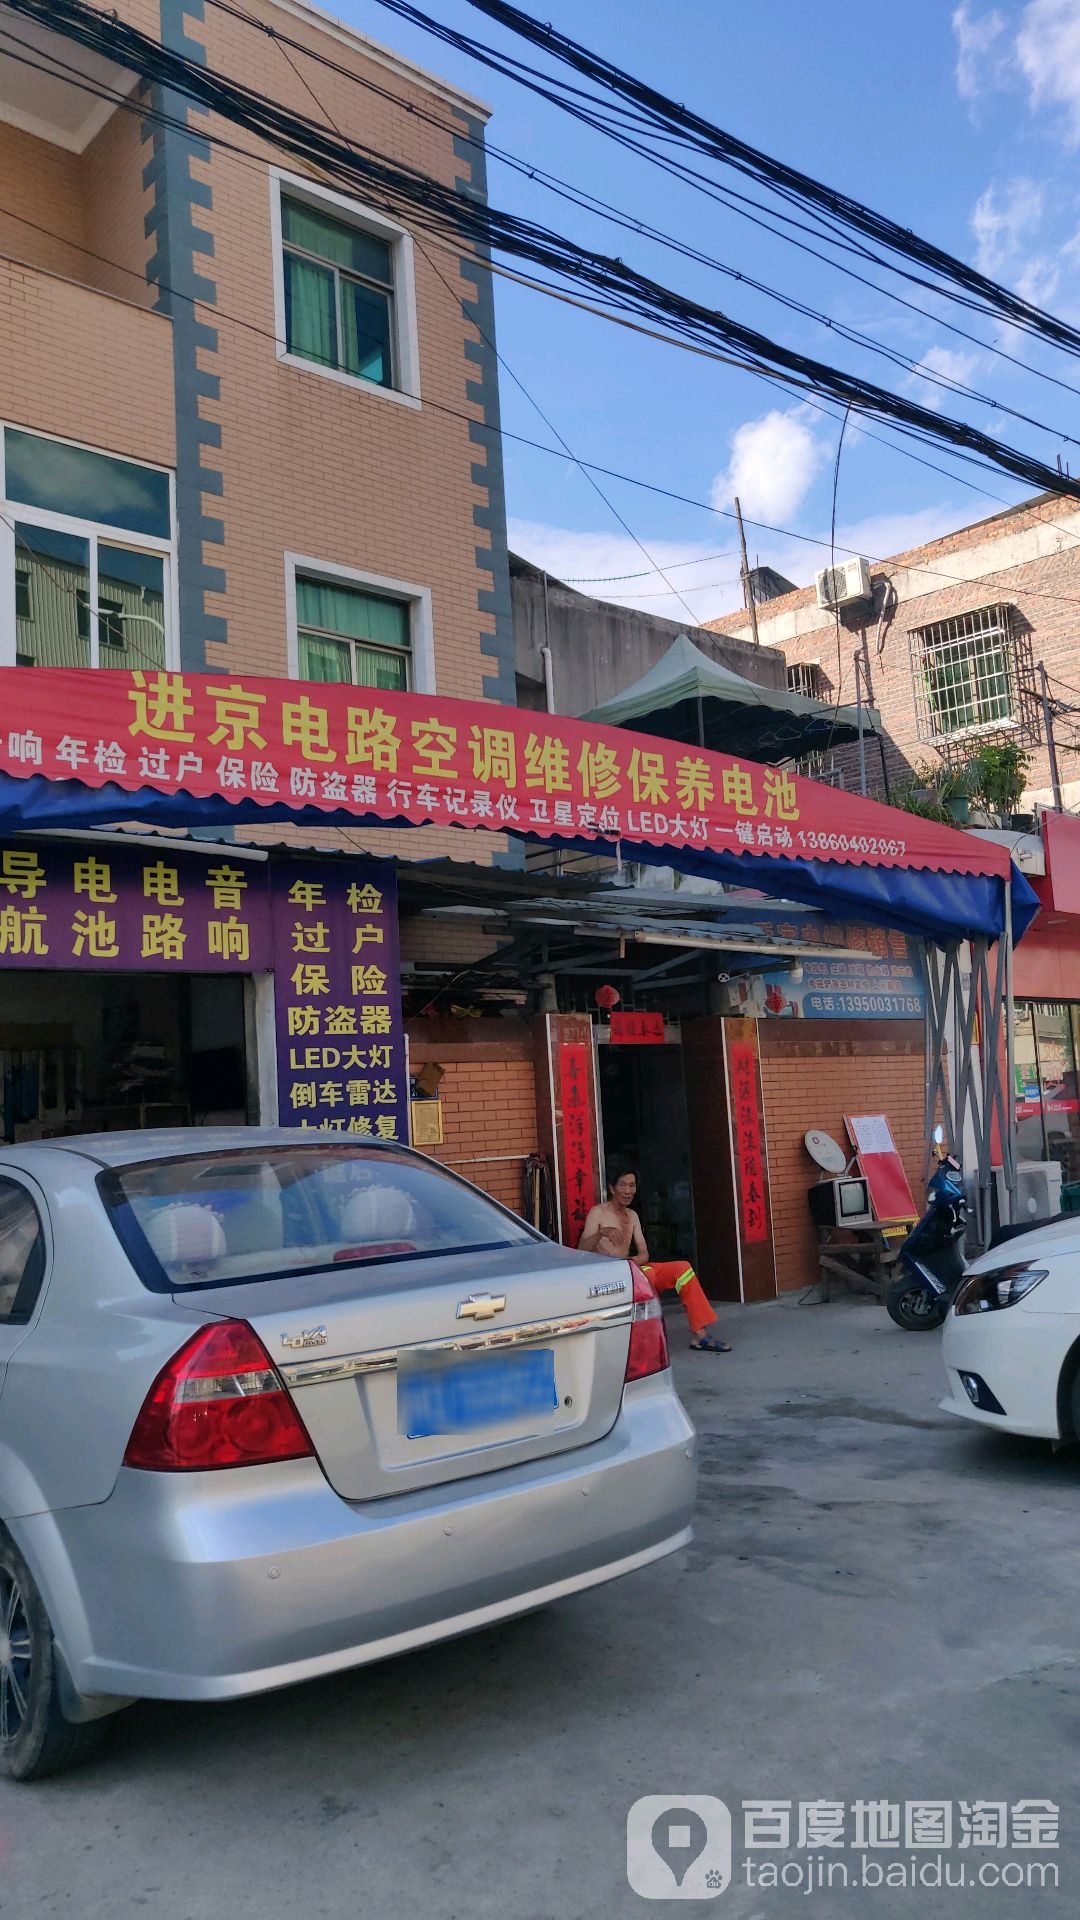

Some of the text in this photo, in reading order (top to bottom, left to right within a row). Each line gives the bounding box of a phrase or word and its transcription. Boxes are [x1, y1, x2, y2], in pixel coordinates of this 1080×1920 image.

[127, 670, 801, 821] 进京电路空调维修保养电池
[0, 730, 906, 857] 响 年检 过户 保险 防盗器 行车记录仪 卫星定位 LED大灯 一键启动 13860402067
[71, 856, 120, 957] 电池
[140, 860, 188, 960] 电路
[205, 865, 250, 961] 音响
[287, 879, 384, 915] 年检
[291, 921, 385, 954] 过户
[290, 963, 388, 996] 保险
[287, 1005, 393, 1036] 防盗器
[289, 1045, 394, 1070] LED大灯
[289, 1078, 398, 1109] 倒车雷达
